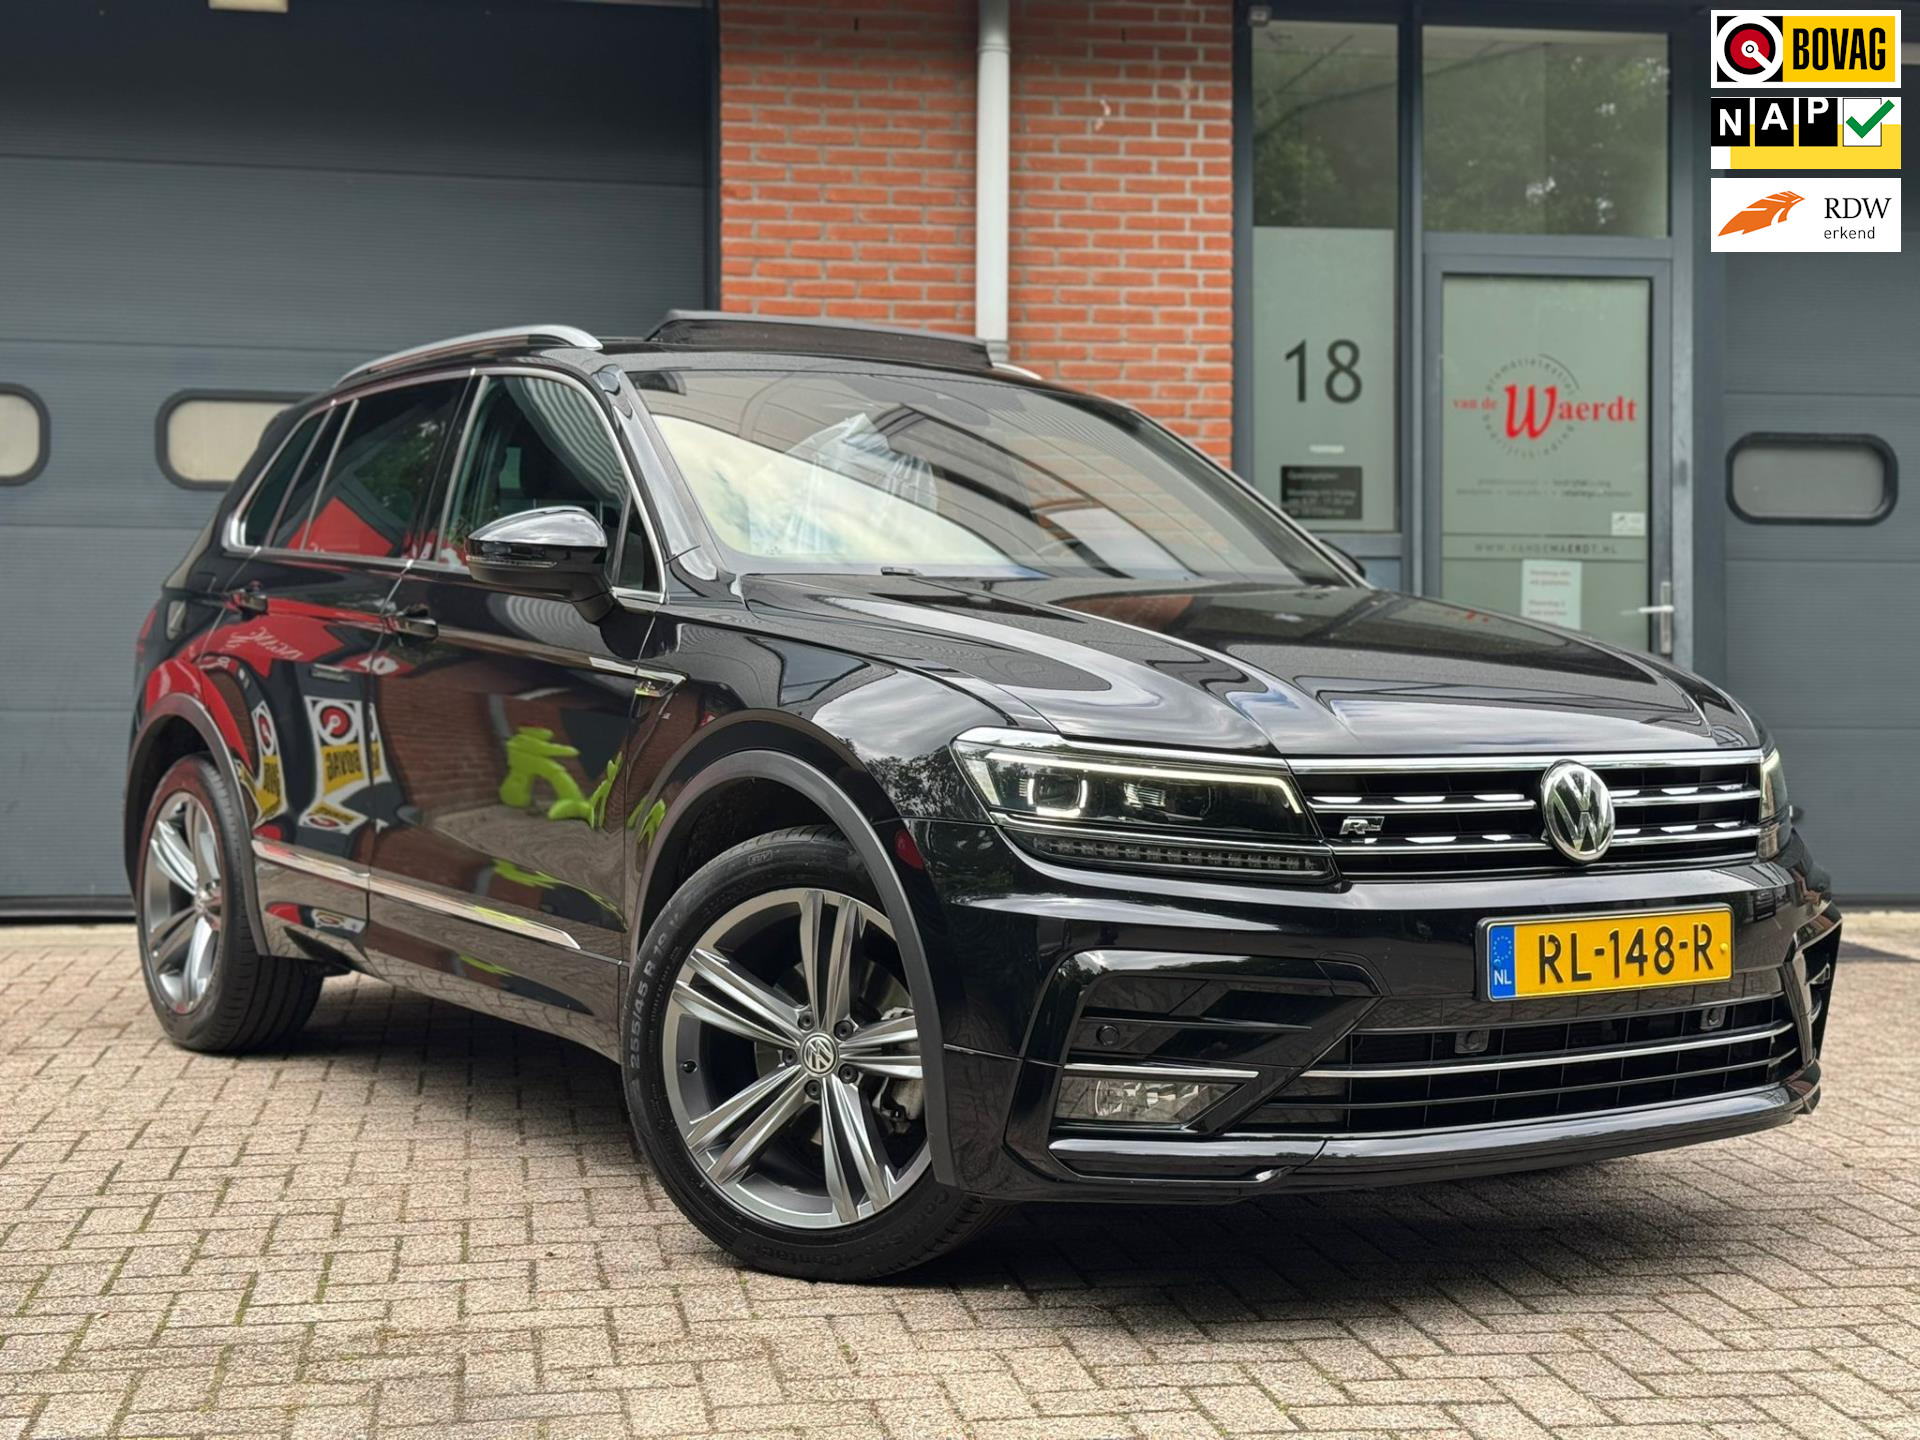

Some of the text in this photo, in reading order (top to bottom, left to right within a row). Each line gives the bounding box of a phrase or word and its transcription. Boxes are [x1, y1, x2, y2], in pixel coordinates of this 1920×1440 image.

[1285, 340, 1362, 404] 18
[1453, 384, 1637, 440] van de Waerdt
[1494, 969, 1512, 986] NL
[1538, 923, 1714, 984] RL-148-R
[630, 981, 649, 1069] 255/45
[643, 960, 656, 976] R
